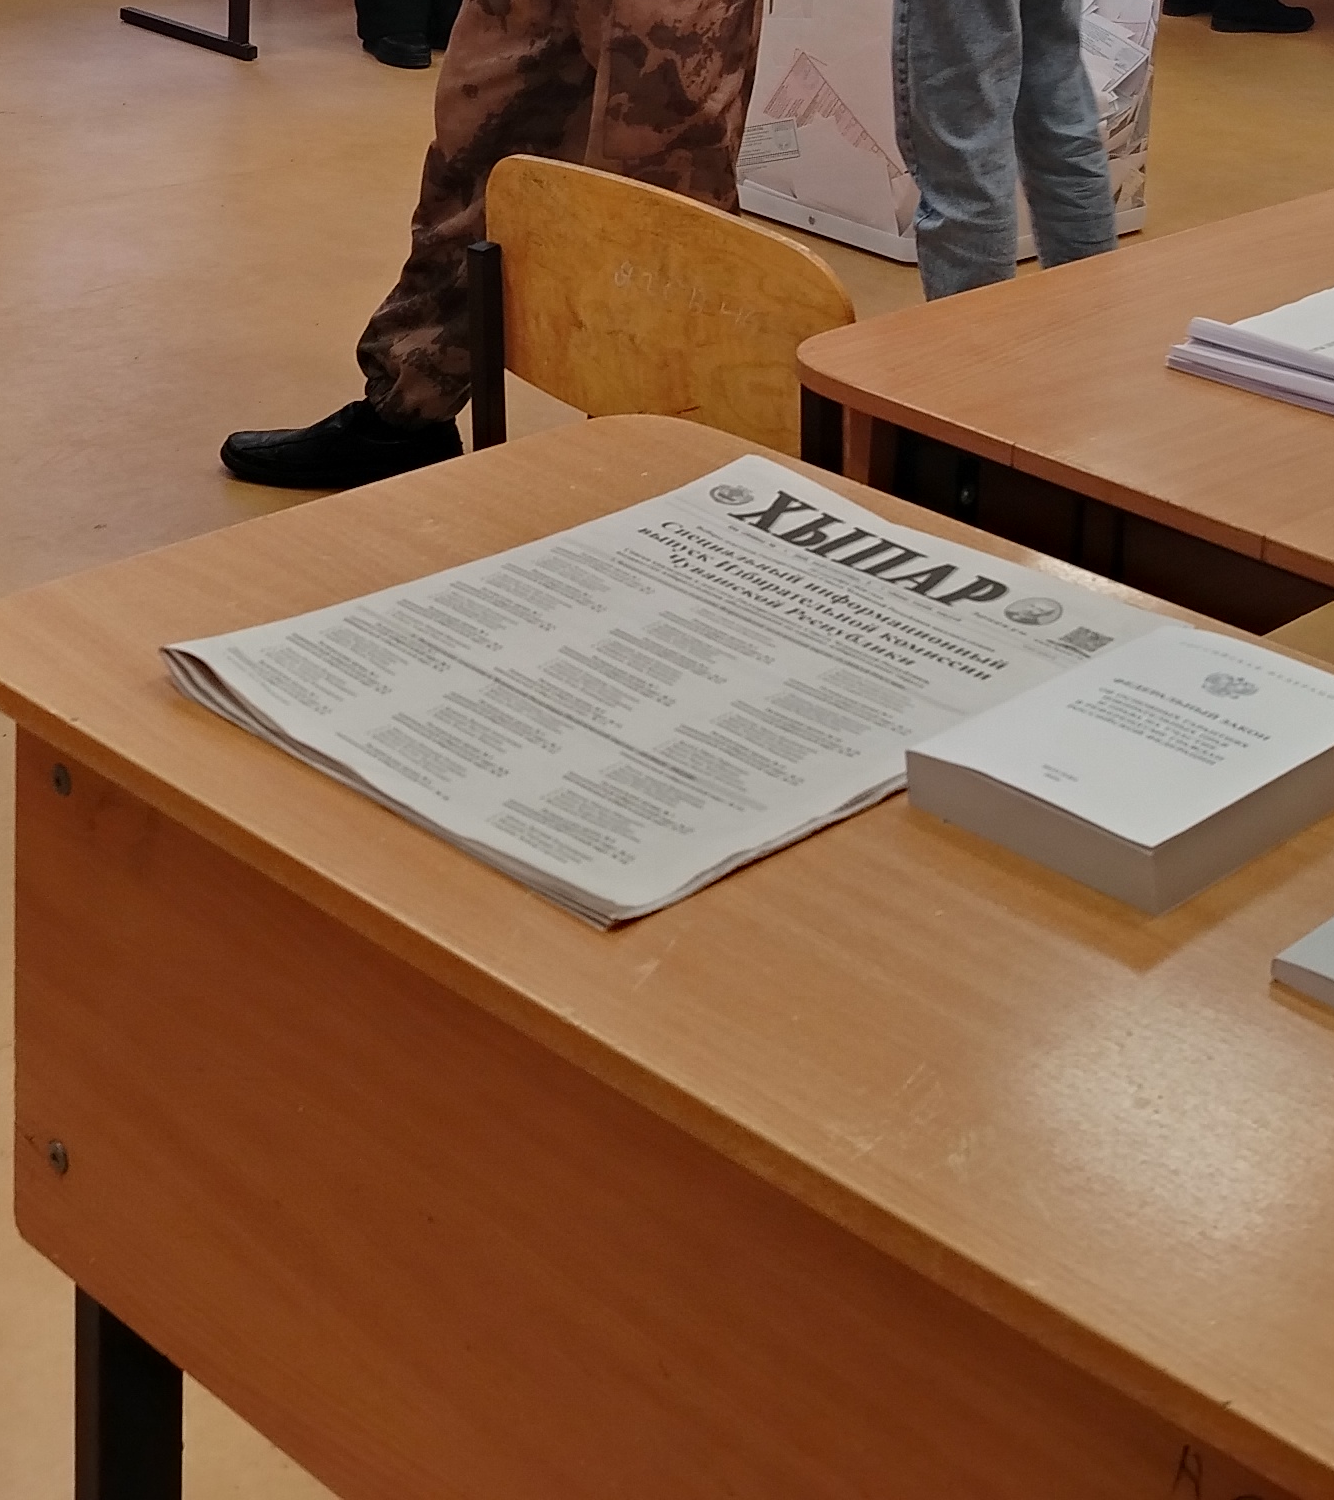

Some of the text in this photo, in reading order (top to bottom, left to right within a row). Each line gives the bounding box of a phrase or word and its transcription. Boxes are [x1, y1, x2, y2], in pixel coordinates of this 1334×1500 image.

[637, 526, 715, 564] выпуск
[714, 560, 879, 635] Избирательной
[879, 630, 993, 681] комиссии
[661, 521, 802, 585] Специальный
[804, 579, 1009, 671] информационный
[727, 490, 1009, 606] ХЫПАР
[668, 553, 783, 609] Чувашской
[784, 606, 916, 666] Республики
[1114, 677, 1219, 720] ФЕДЕРАЛЬНЫЙ
[1221, 718, 1270, 741] ЗАКОН
